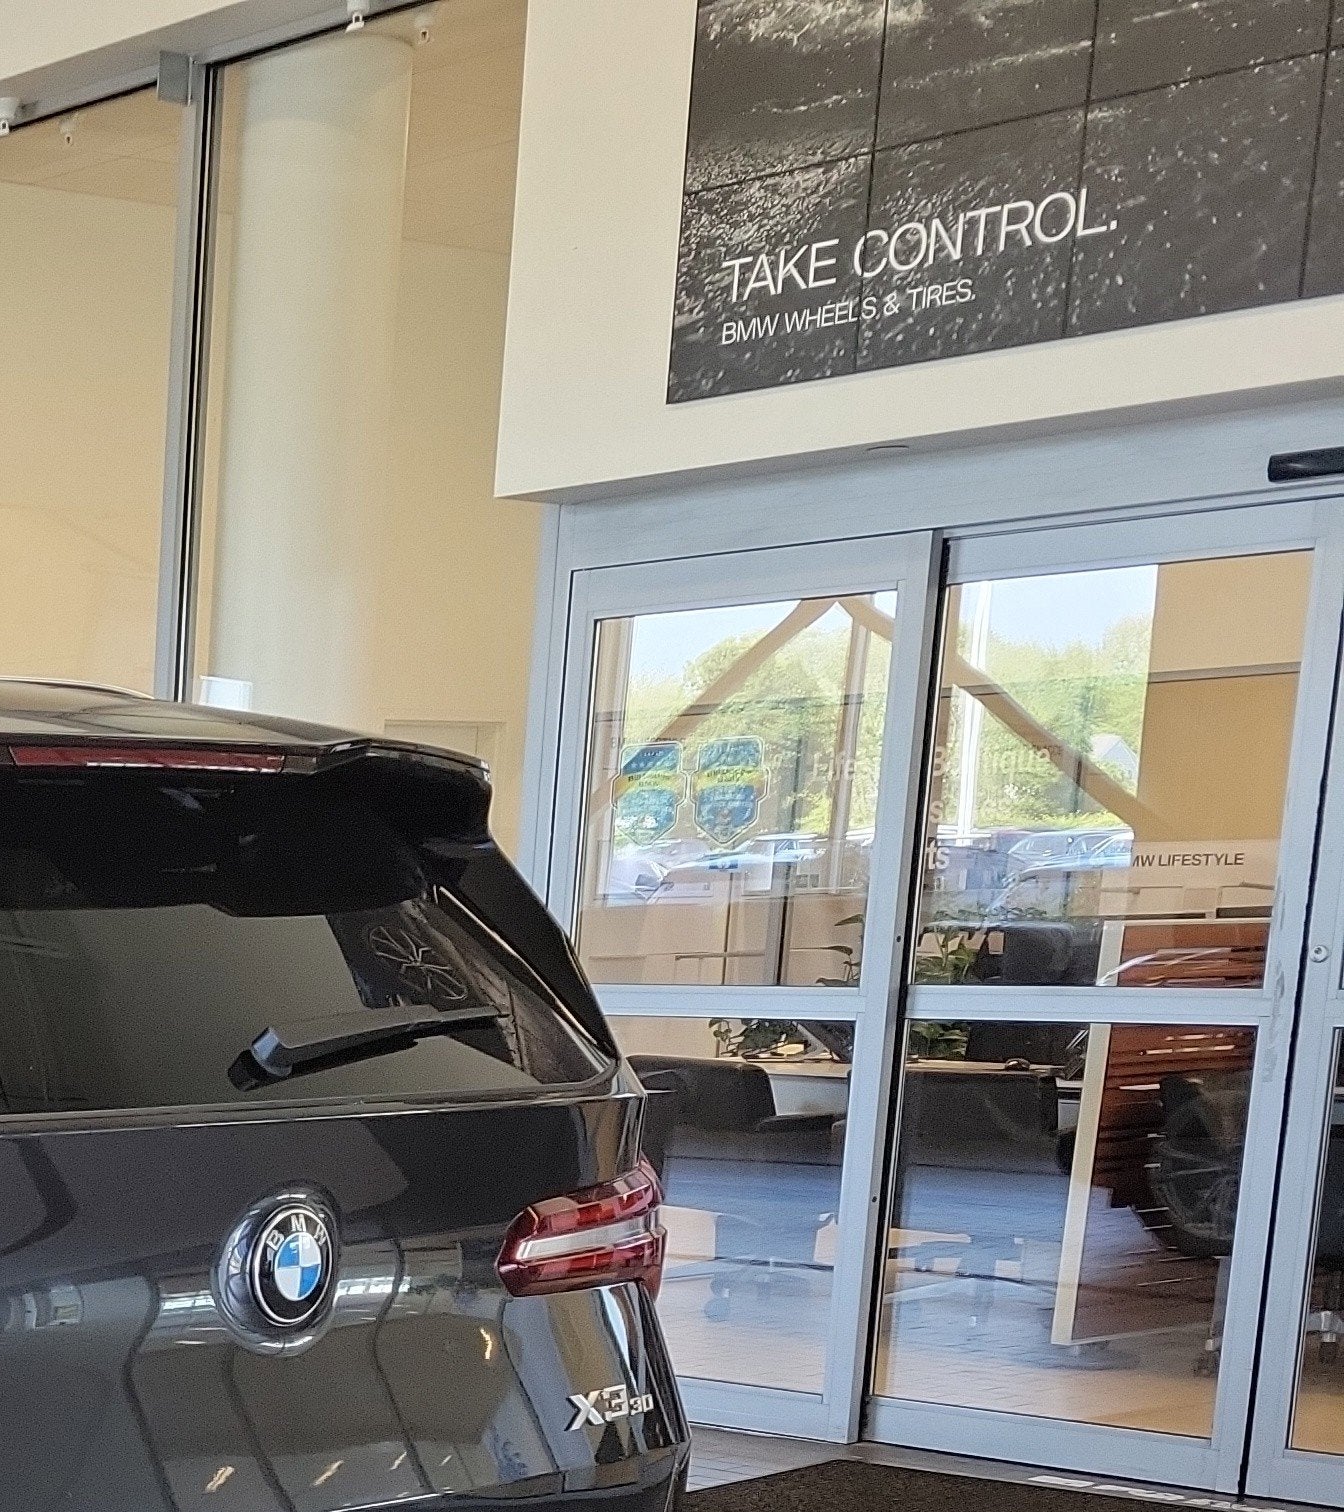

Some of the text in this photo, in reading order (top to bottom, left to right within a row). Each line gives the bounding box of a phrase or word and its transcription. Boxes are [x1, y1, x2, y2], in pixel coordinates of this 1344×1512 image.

[721, 187, 1118, 303] TAKE CONTROL.
[720, 279, 976, 346] BMW WHEELS & TIRES.
[1132, 853, 1245, 867] MW LIFESTYLE
[266, 1213, 328, 1252] BMW
